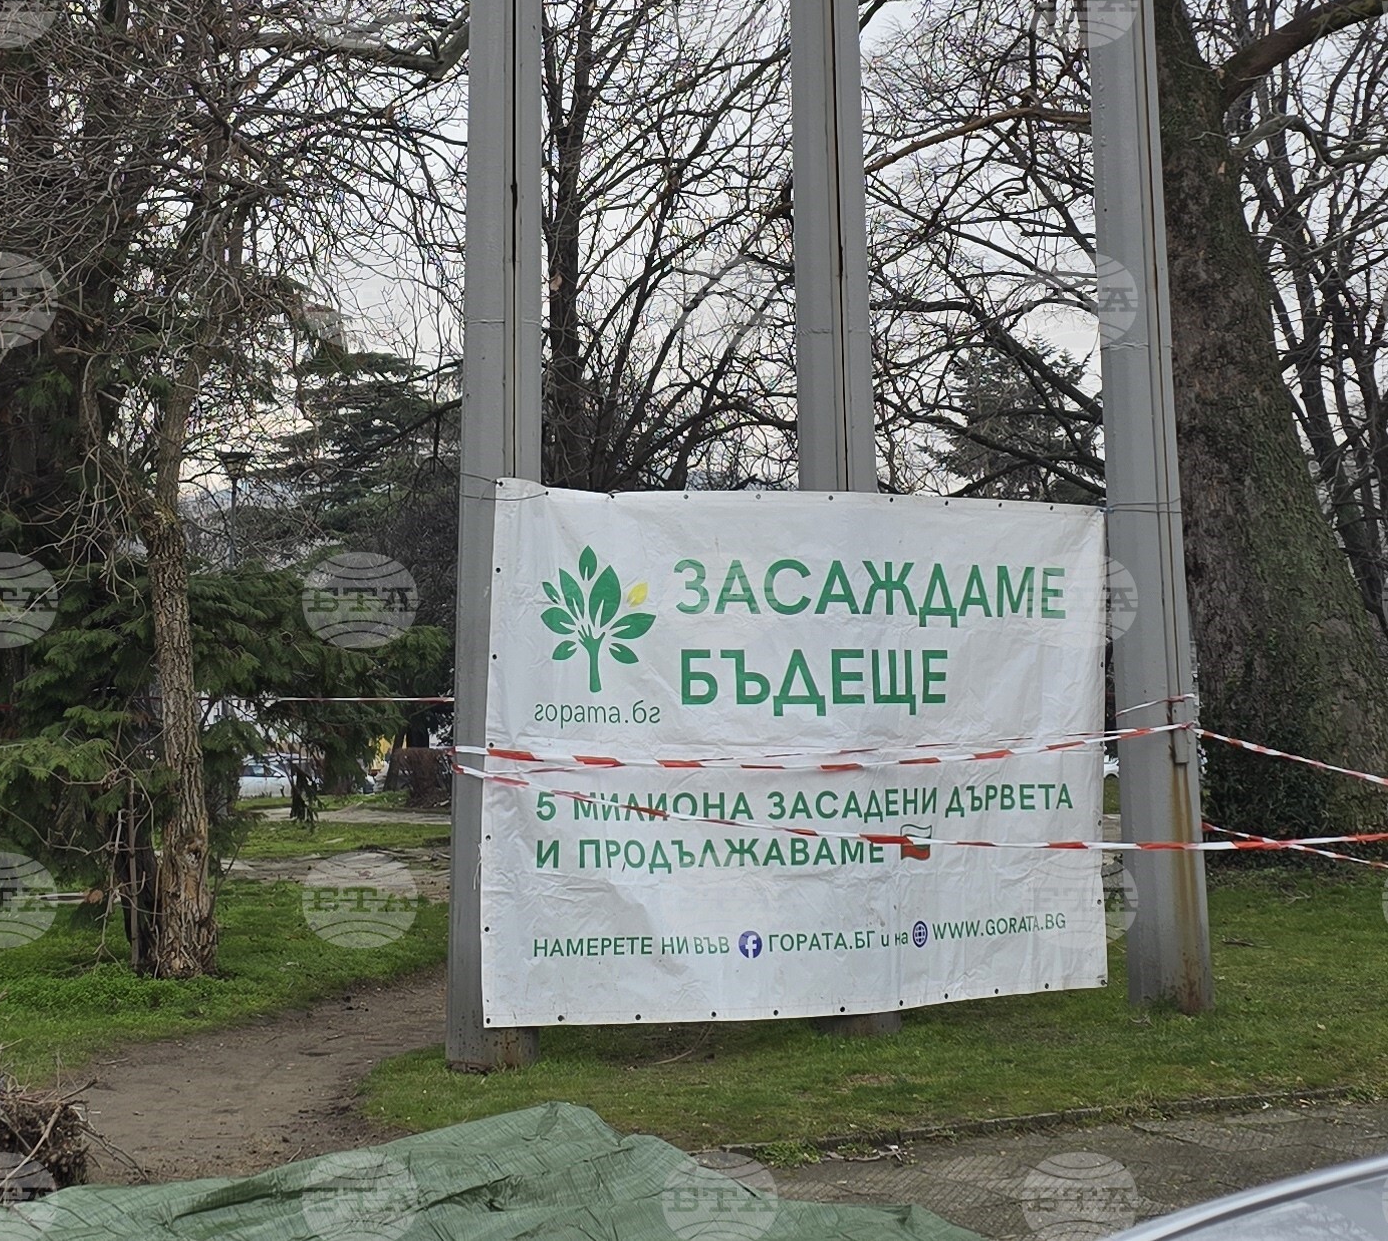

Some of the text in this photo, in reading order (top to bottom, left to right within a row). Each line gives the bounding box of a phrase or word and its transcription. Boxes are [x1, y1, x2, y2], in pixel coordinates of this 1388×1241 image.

[673, 558, 1066, 628] ЗАСАЖДАМЕ
[681, 648, 948, 716] БЪДЕЩЕ
[534, 700, 661, 729] гората.бг
[536, 783, 1073, 823] 5 МИЛИОНА ЗАСАДЕНИ ДЪРВЕТА
[536, 838, 884, 874] И ПРОДЪЛЖАВАМЕ
[533, 937, 653, 957] НАМЕРЕТЕ
[662, 937, 689, 955] НИ
[694, 936, 730, 955] ВЪВ
[769, 930, 876, 952] ГОРАТА.БГ
[894, 931, 909, 946] на
[932, 912, 1066, 940] WWW.GORATA.BG
